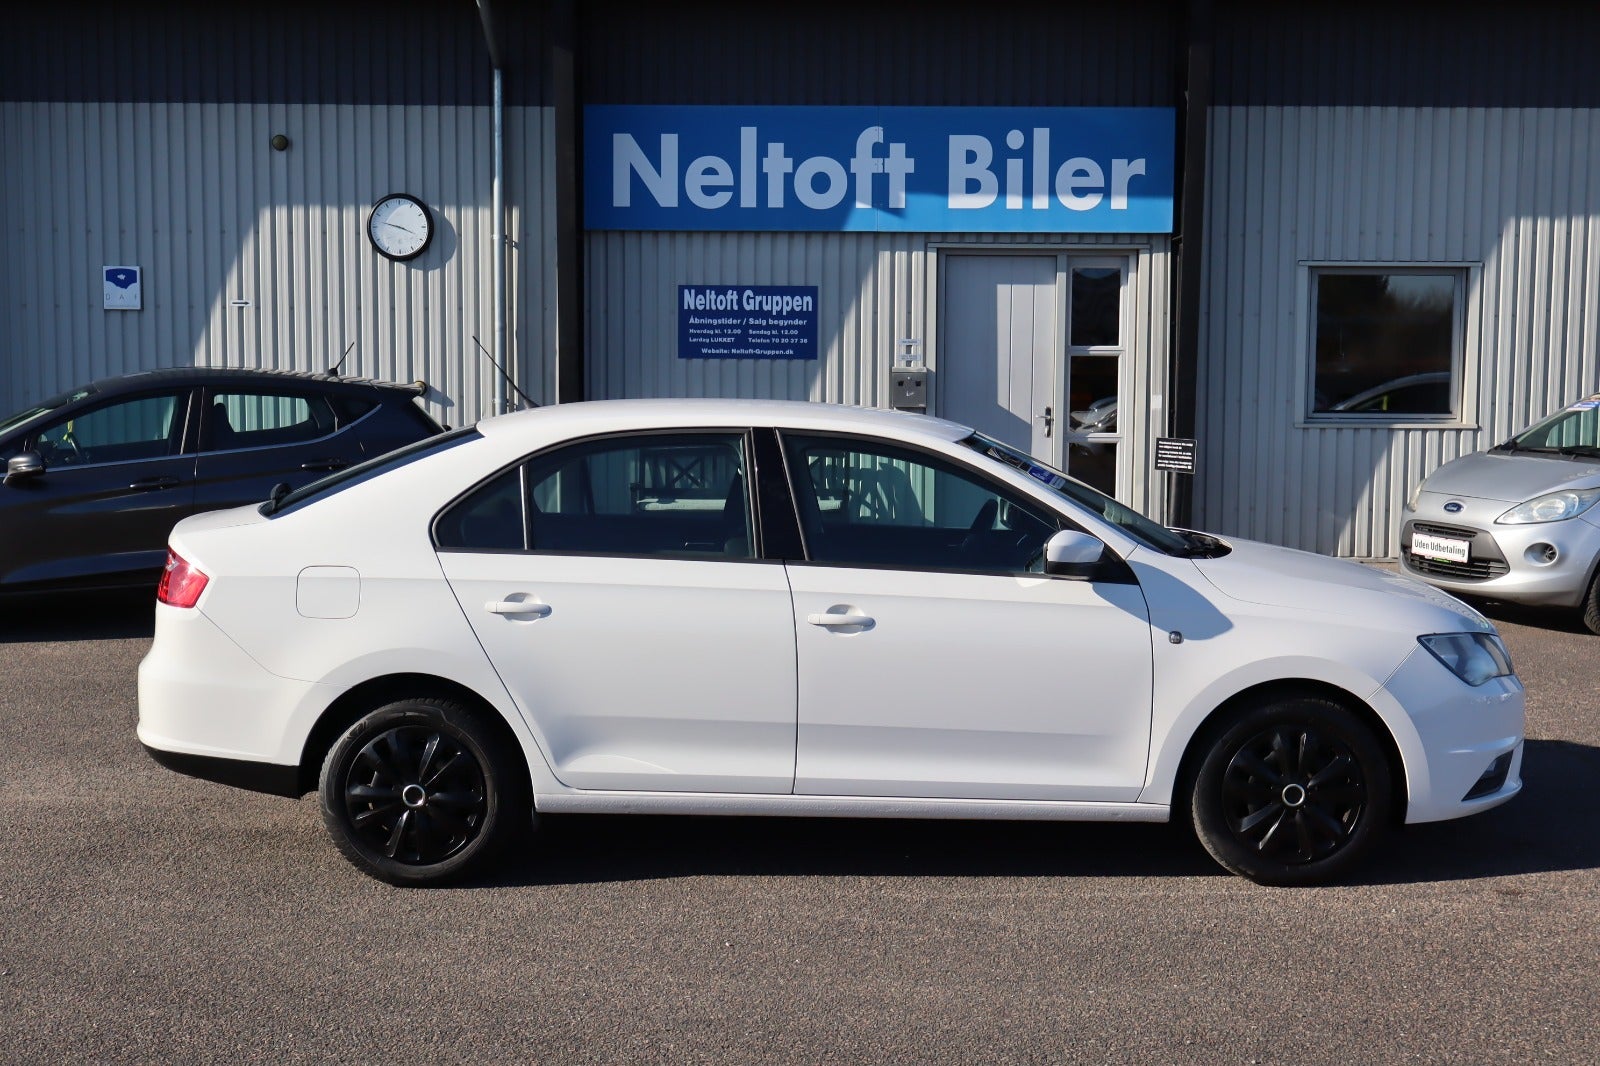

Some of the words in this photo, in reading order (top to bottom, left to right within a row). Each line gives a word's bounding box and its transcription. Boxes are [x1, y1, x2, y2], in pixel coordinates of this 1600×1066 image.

[612, 126, 915, 209] Neltoft
[947, 128, 1146, 211] Biler
[684, 289, 738, 310] Neltoft
[743, 289, 812, 315] Gruppen
[689, 315, 741, 326] Åbningstider
[749, 317, 767, 326] Salg
[769, 318, 807, 327] begynder
[1414, 539, 1429, 550] Uden
[1431, 542, 1466, 557] Udbetaling
